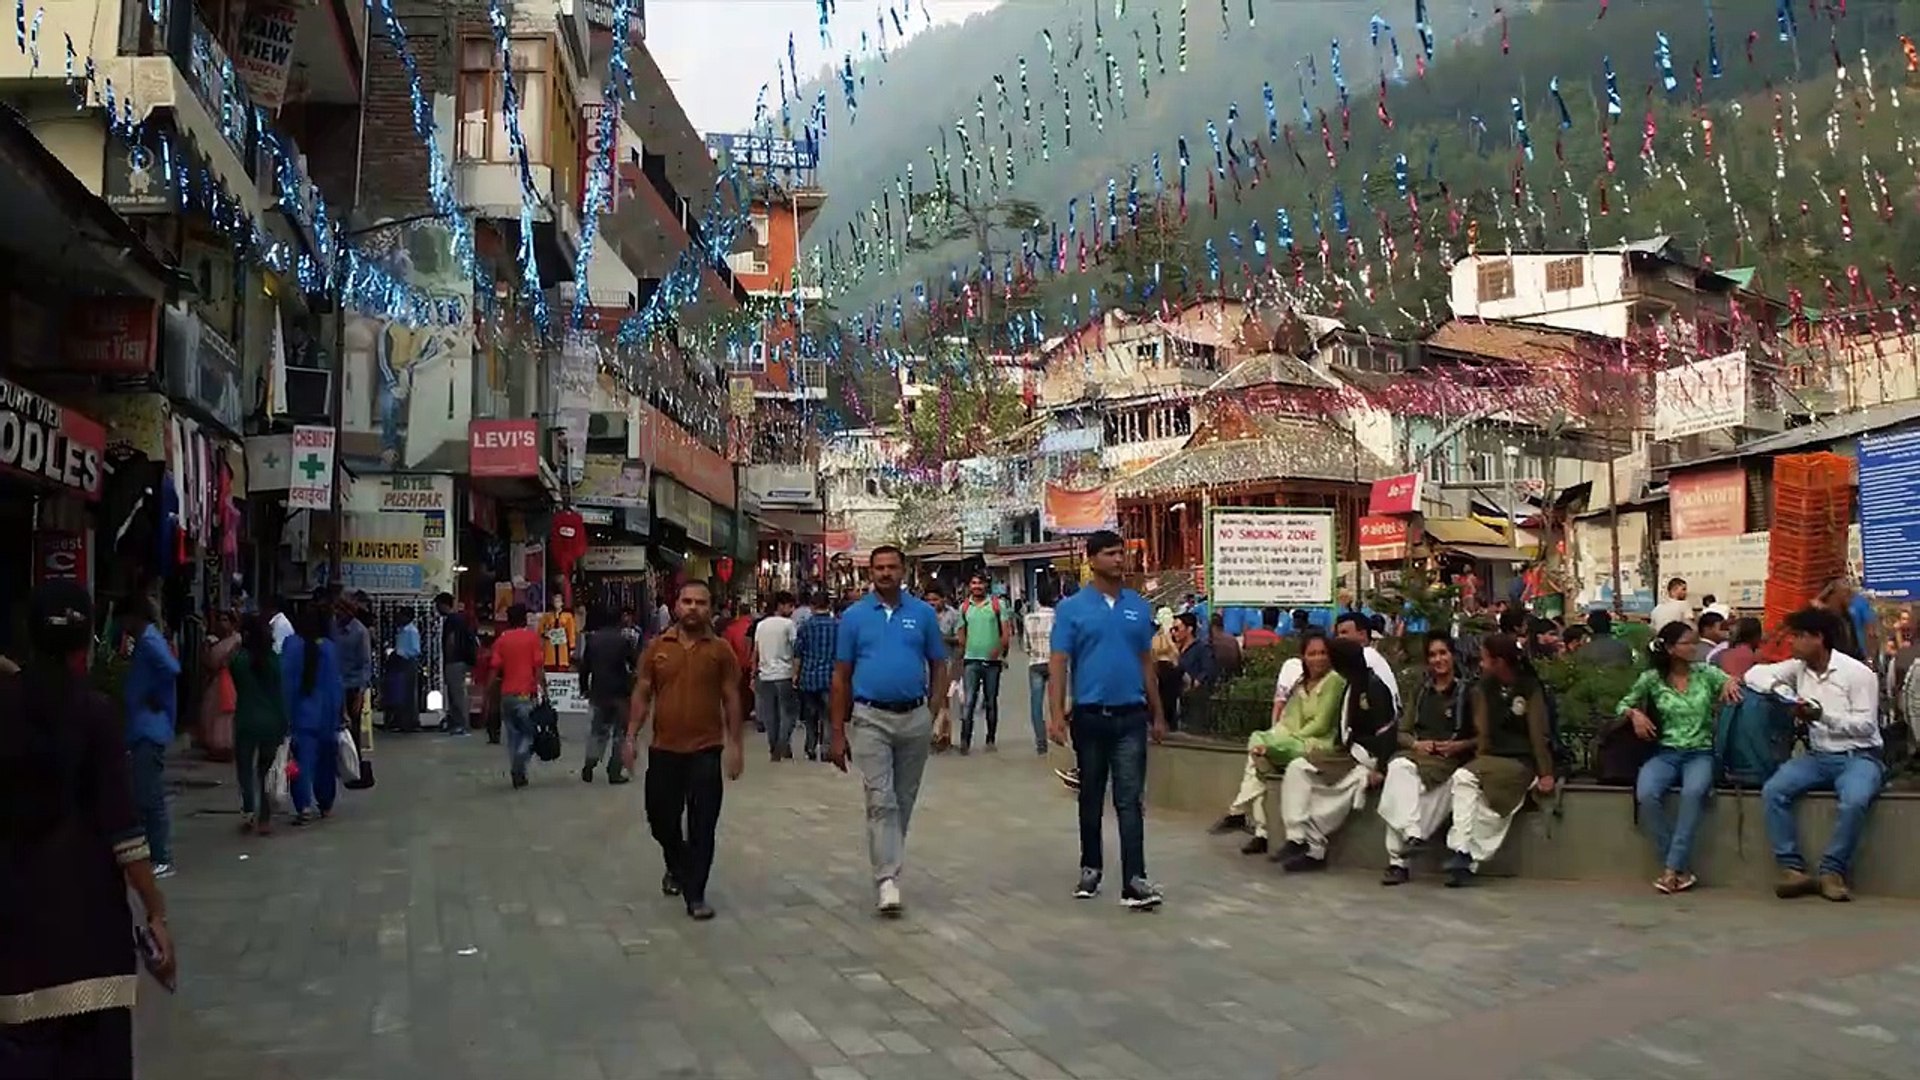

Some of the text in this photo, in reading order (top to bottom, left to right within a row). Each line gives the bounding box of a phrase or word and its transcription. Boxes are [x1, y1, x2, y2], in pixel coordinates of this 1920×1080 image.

[473, 430, 536, 448] LEVI'S
[383, 492, 443, 507] PUSHPAK
[1219, 528, 1317, 541] NO SMOKING ZONE
[356, 541, 419, 559] ADVENTURE
